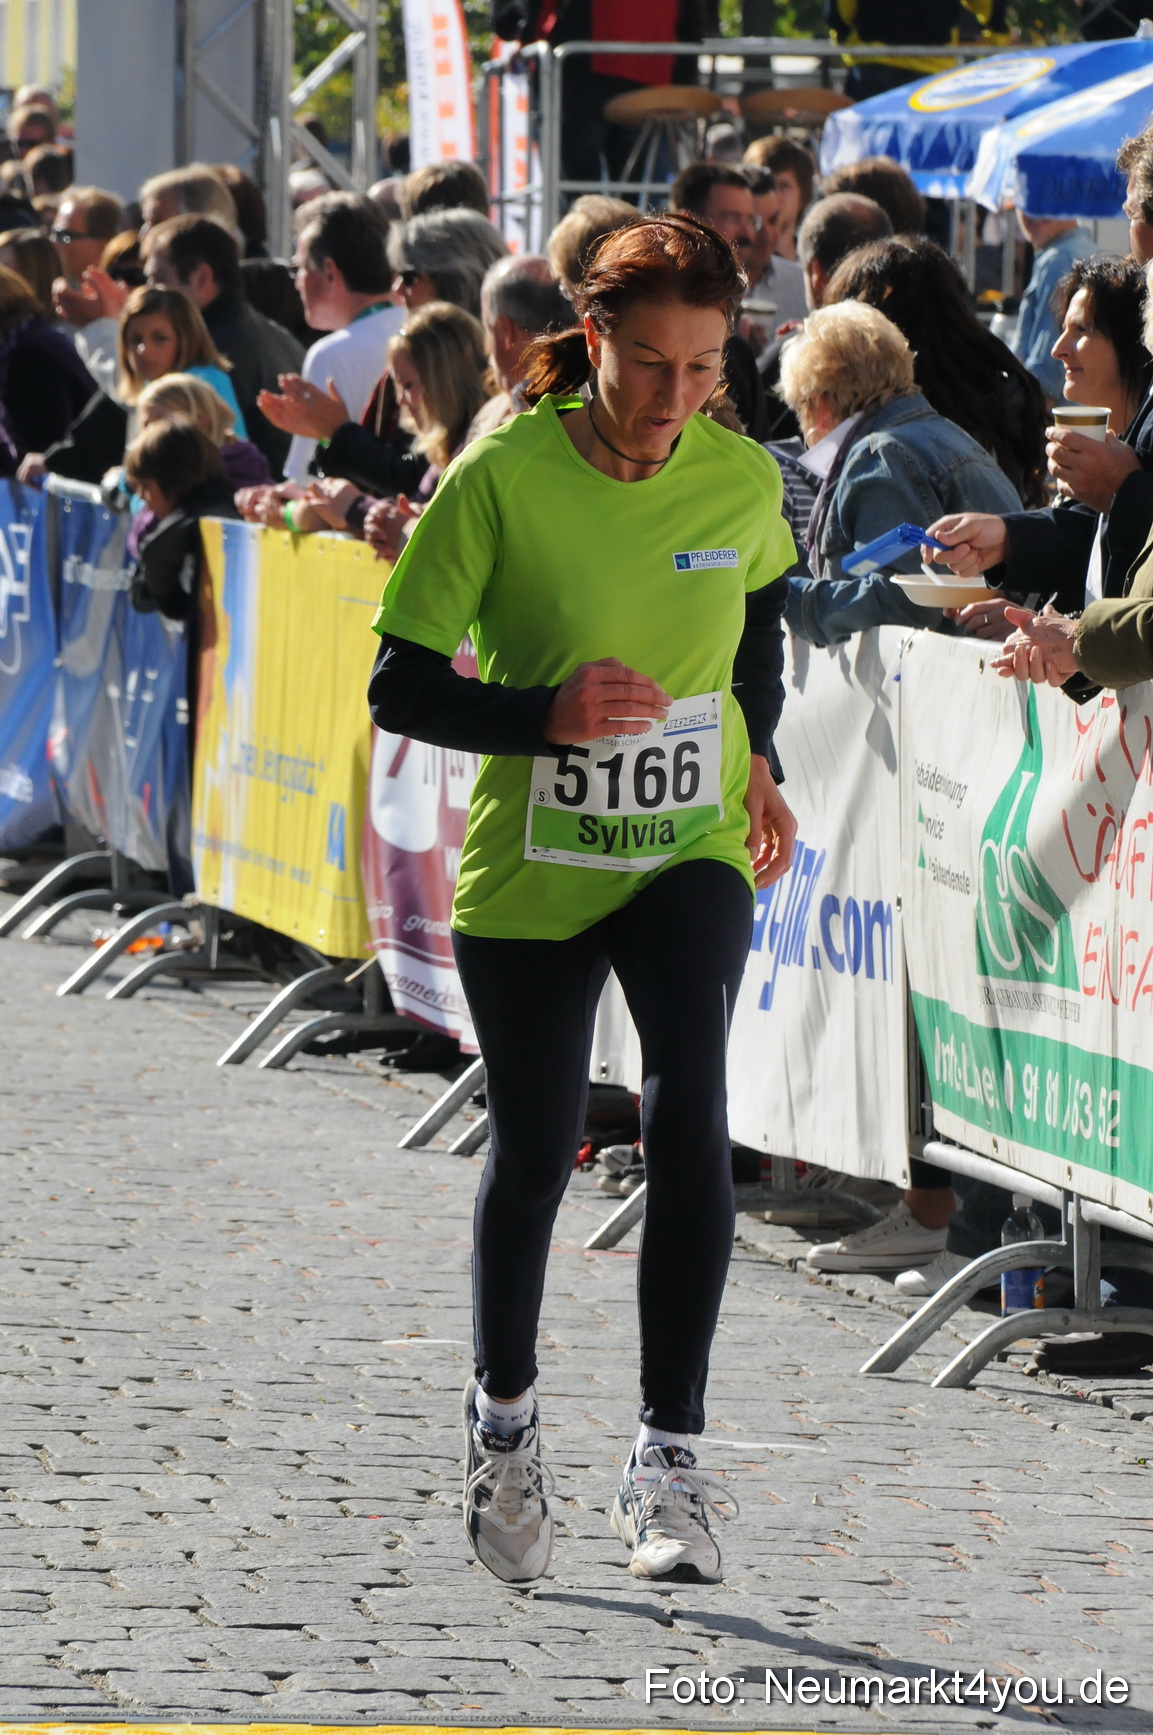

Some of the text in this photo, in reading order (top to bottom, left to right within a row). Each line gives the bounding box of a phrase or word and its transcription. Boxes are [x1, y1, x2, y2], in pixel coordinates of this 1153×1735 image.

[690, 550, 737, 562] PFLEIDERER
[664, 712, 707, 731] BOCK
[553, 740, 701, 810] 5166
[538, 790, 546, 803] S
[577, 814, 676, 854] Sylvia
[1022, 1063, 1039, 1122] 91
[1045, 1068, 1059, 1129] 81
[1098, 1086, 1121, 1148] 52
[486, 1407, 528, 1422] TOP FIT
